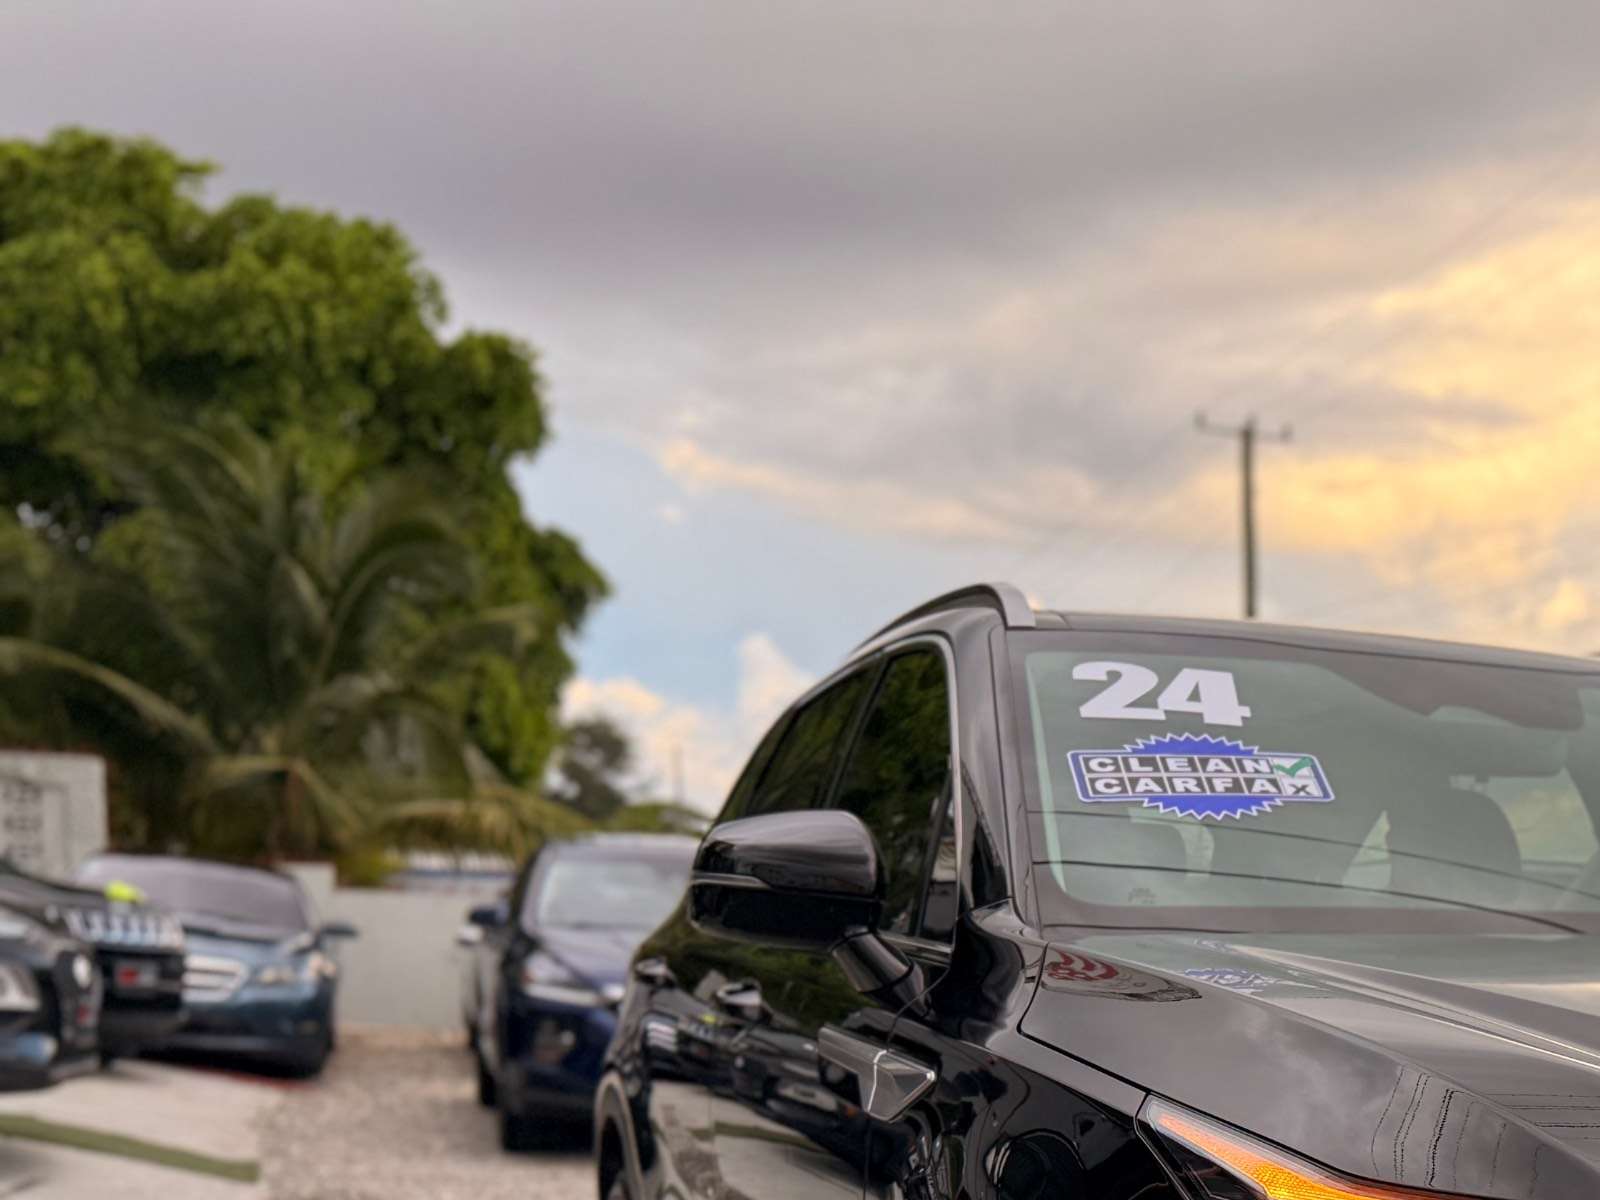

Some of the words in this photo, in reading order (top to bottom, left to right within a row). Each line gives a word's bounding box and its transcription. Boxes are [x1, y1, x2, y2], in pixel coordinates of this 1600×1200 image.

[1072, 661, 1251, 727] 24
[1088, 757, 1273, 775] CLEAN
[1094, 777, 1316, 796] CARFAX
